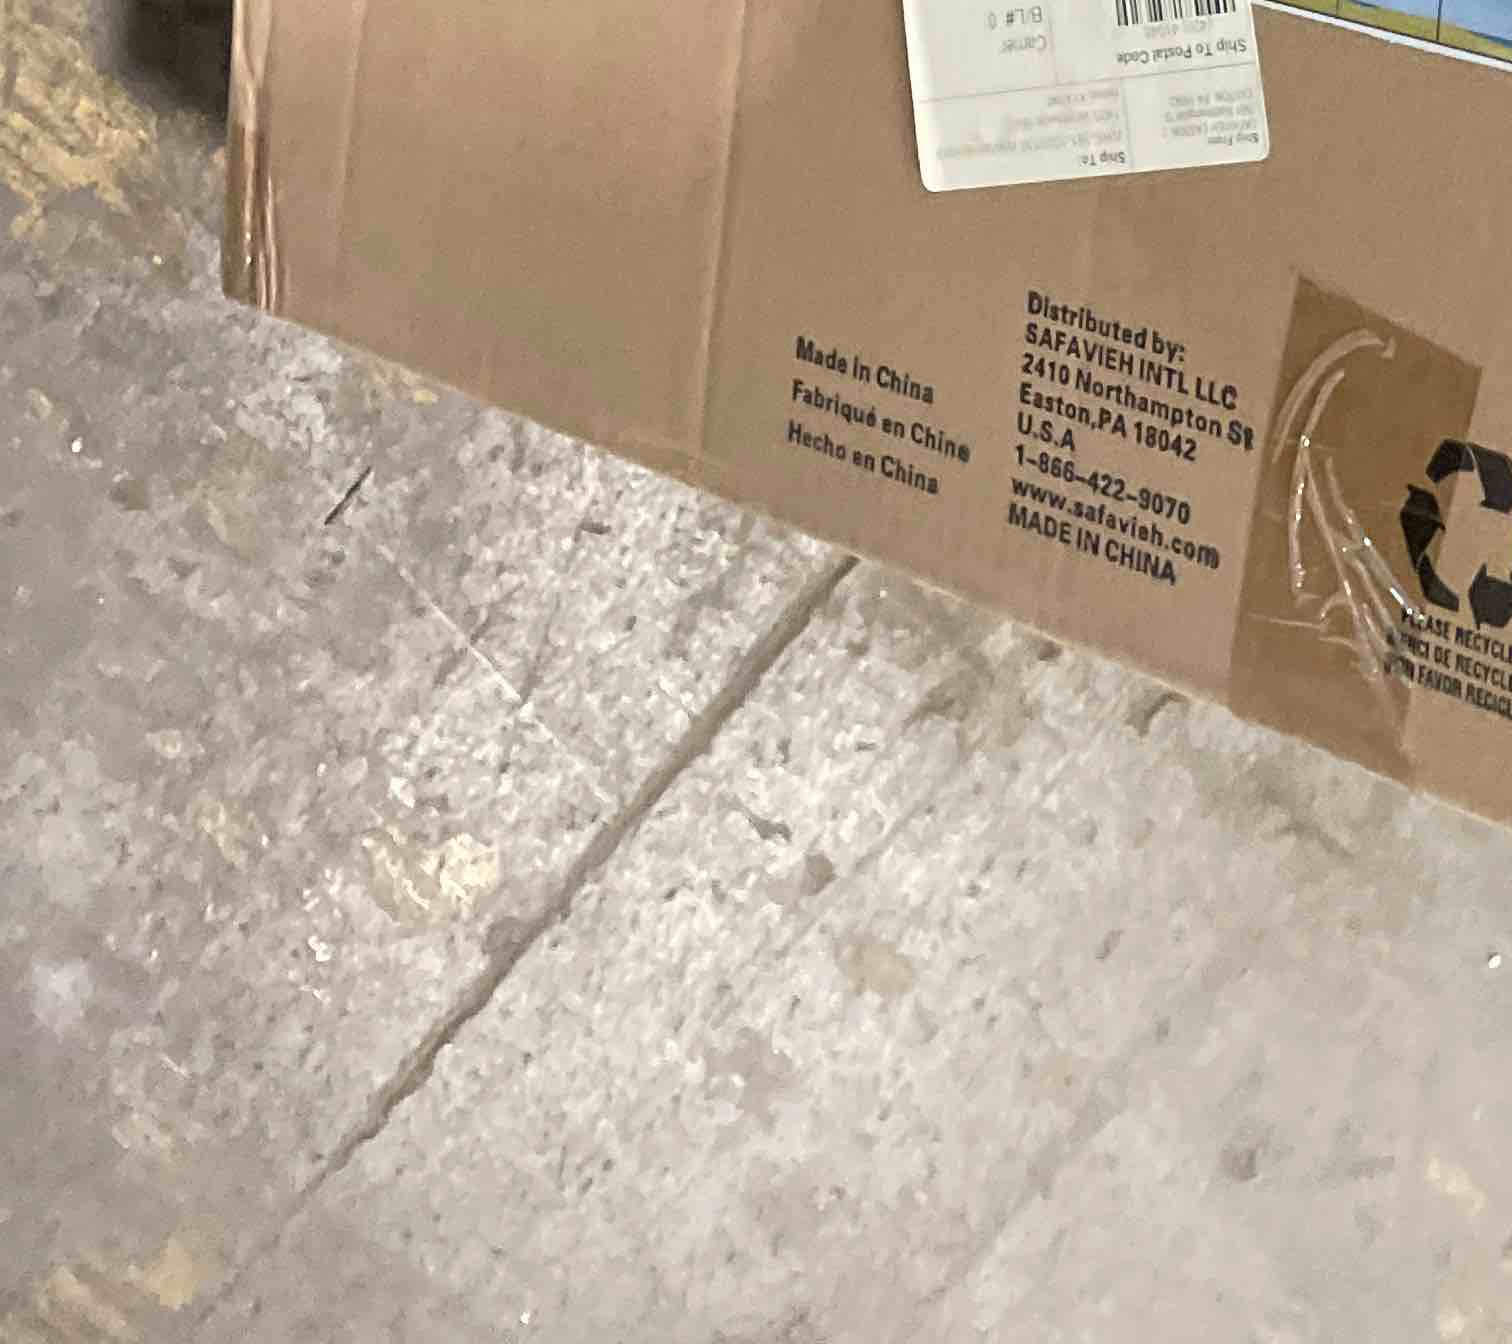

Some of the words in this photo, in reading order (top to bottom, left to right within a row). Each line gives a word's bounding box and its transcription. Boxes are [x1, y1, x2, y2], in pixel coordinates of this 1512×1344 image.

[1116, 50, 1150, 66] Code
[1152, 46, 1192, 60] Postal
[1195, 43, 1213, 57] To
[1216, 38, 1247, 53] Ship
[1026, 291, 1148, 350] Distributed
[795, 336, 848, 374] Made
[852, 357, 871, 384] in
[875, 366, 935, 405] China
[1025, 322, 1133, 376] SAFAVIEH
[1194, 375, 1238, 410] LLC
[1022, 352, 1071, 386] 2410
[1075, 368, 1223, 438] Northampton
[787, 420, 845, 460] Hecho
[851, 447, 875, 473] en
[880, 456, 939, 495] China
[881, 414, 906, 440] en
[910, 424, 970, 463] Chine
[1133, 414, 1198, 462] 18042
[1013, 444, 1191, 525] 1-866-422-9070
[1007, 502, 1072, 544] MADE
[1076, 527, 1100, 556] IN
[1104, 535, 1176, 585] CHINA
[1011, 477, 1220, 569] www.safavieh.com
[1417, 664, 1462, 700] FAVOR
[1433, 645, 1451, 668] DE
